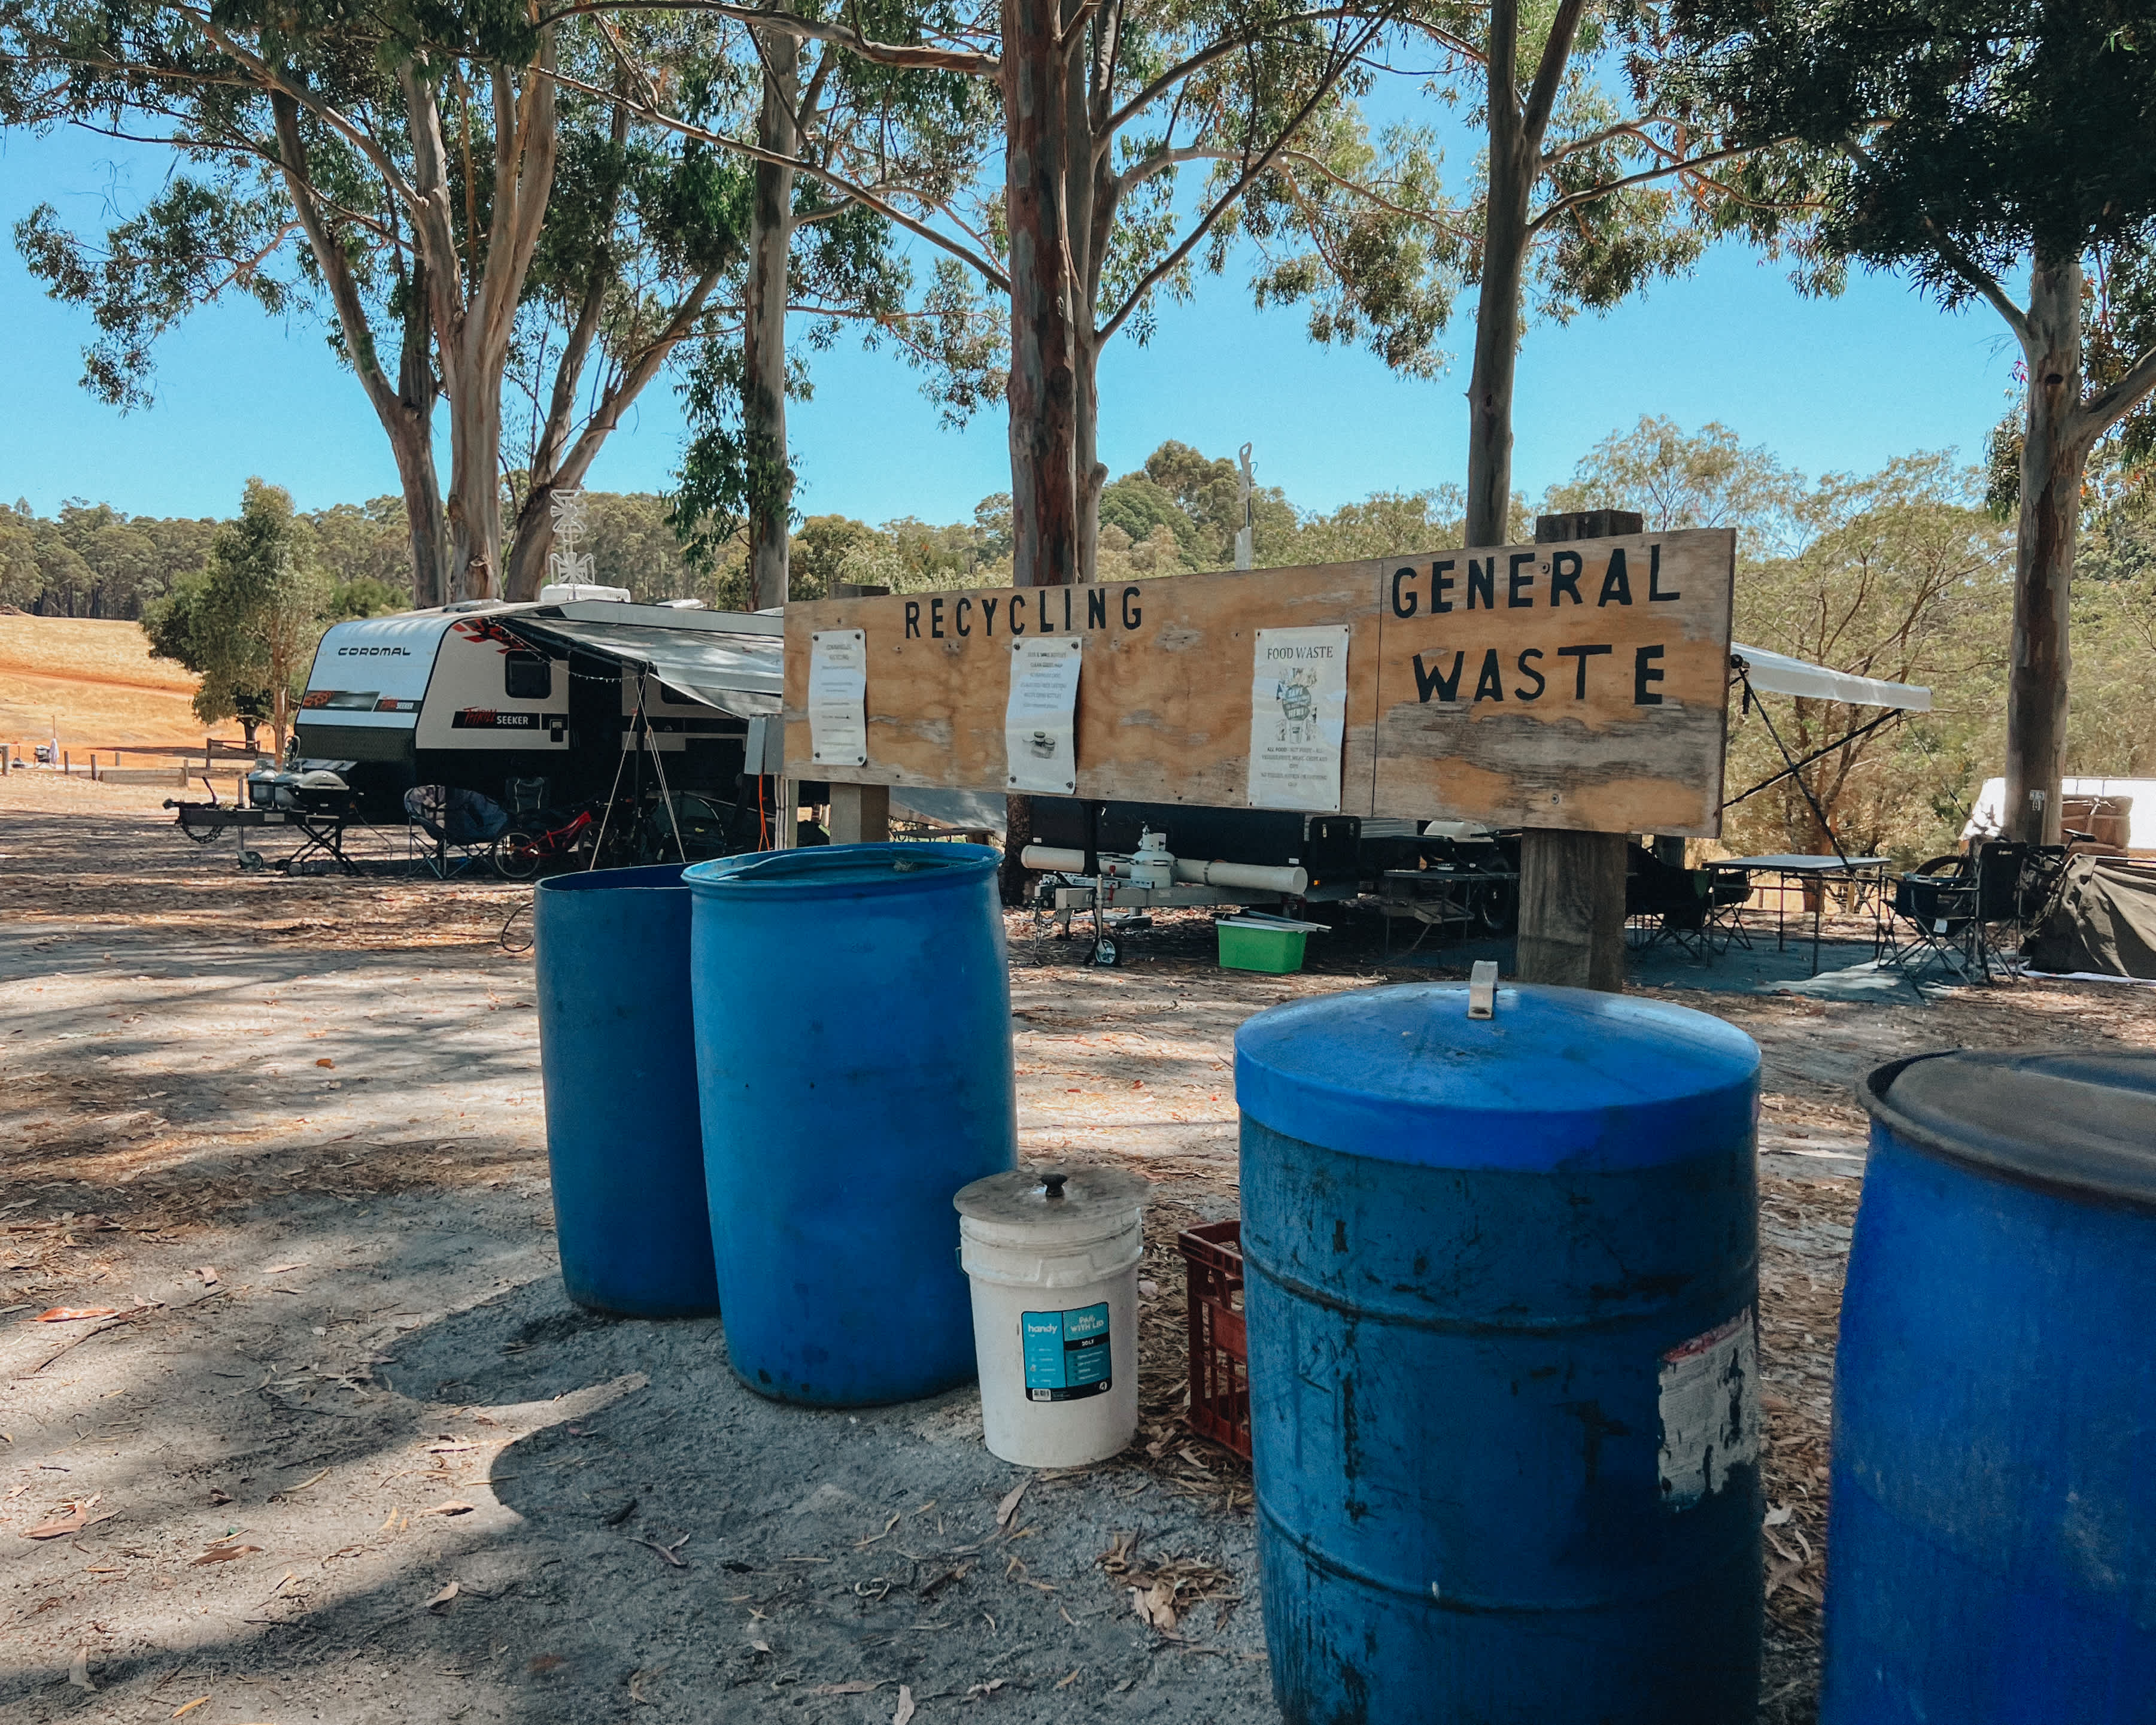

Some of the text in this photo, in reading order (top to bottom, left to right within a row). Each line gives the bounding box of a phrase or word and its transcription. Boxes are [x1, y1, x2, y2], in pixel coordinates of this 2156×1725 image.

[1392, 543, 1681, 618] GENERAL
[905, 586, 1142, 639] RECYCLING
[338, 646, 411, 656] COROMAL
[1267, 646, 1334, 660] FOOD WASTE
[1413, 644, 1665, 705] WASTE
[496, 715, 529, 725] SEEKER
[1028, 1323, 1058, 1335] handy
[1092, 1320, 1104, 1329] LID
